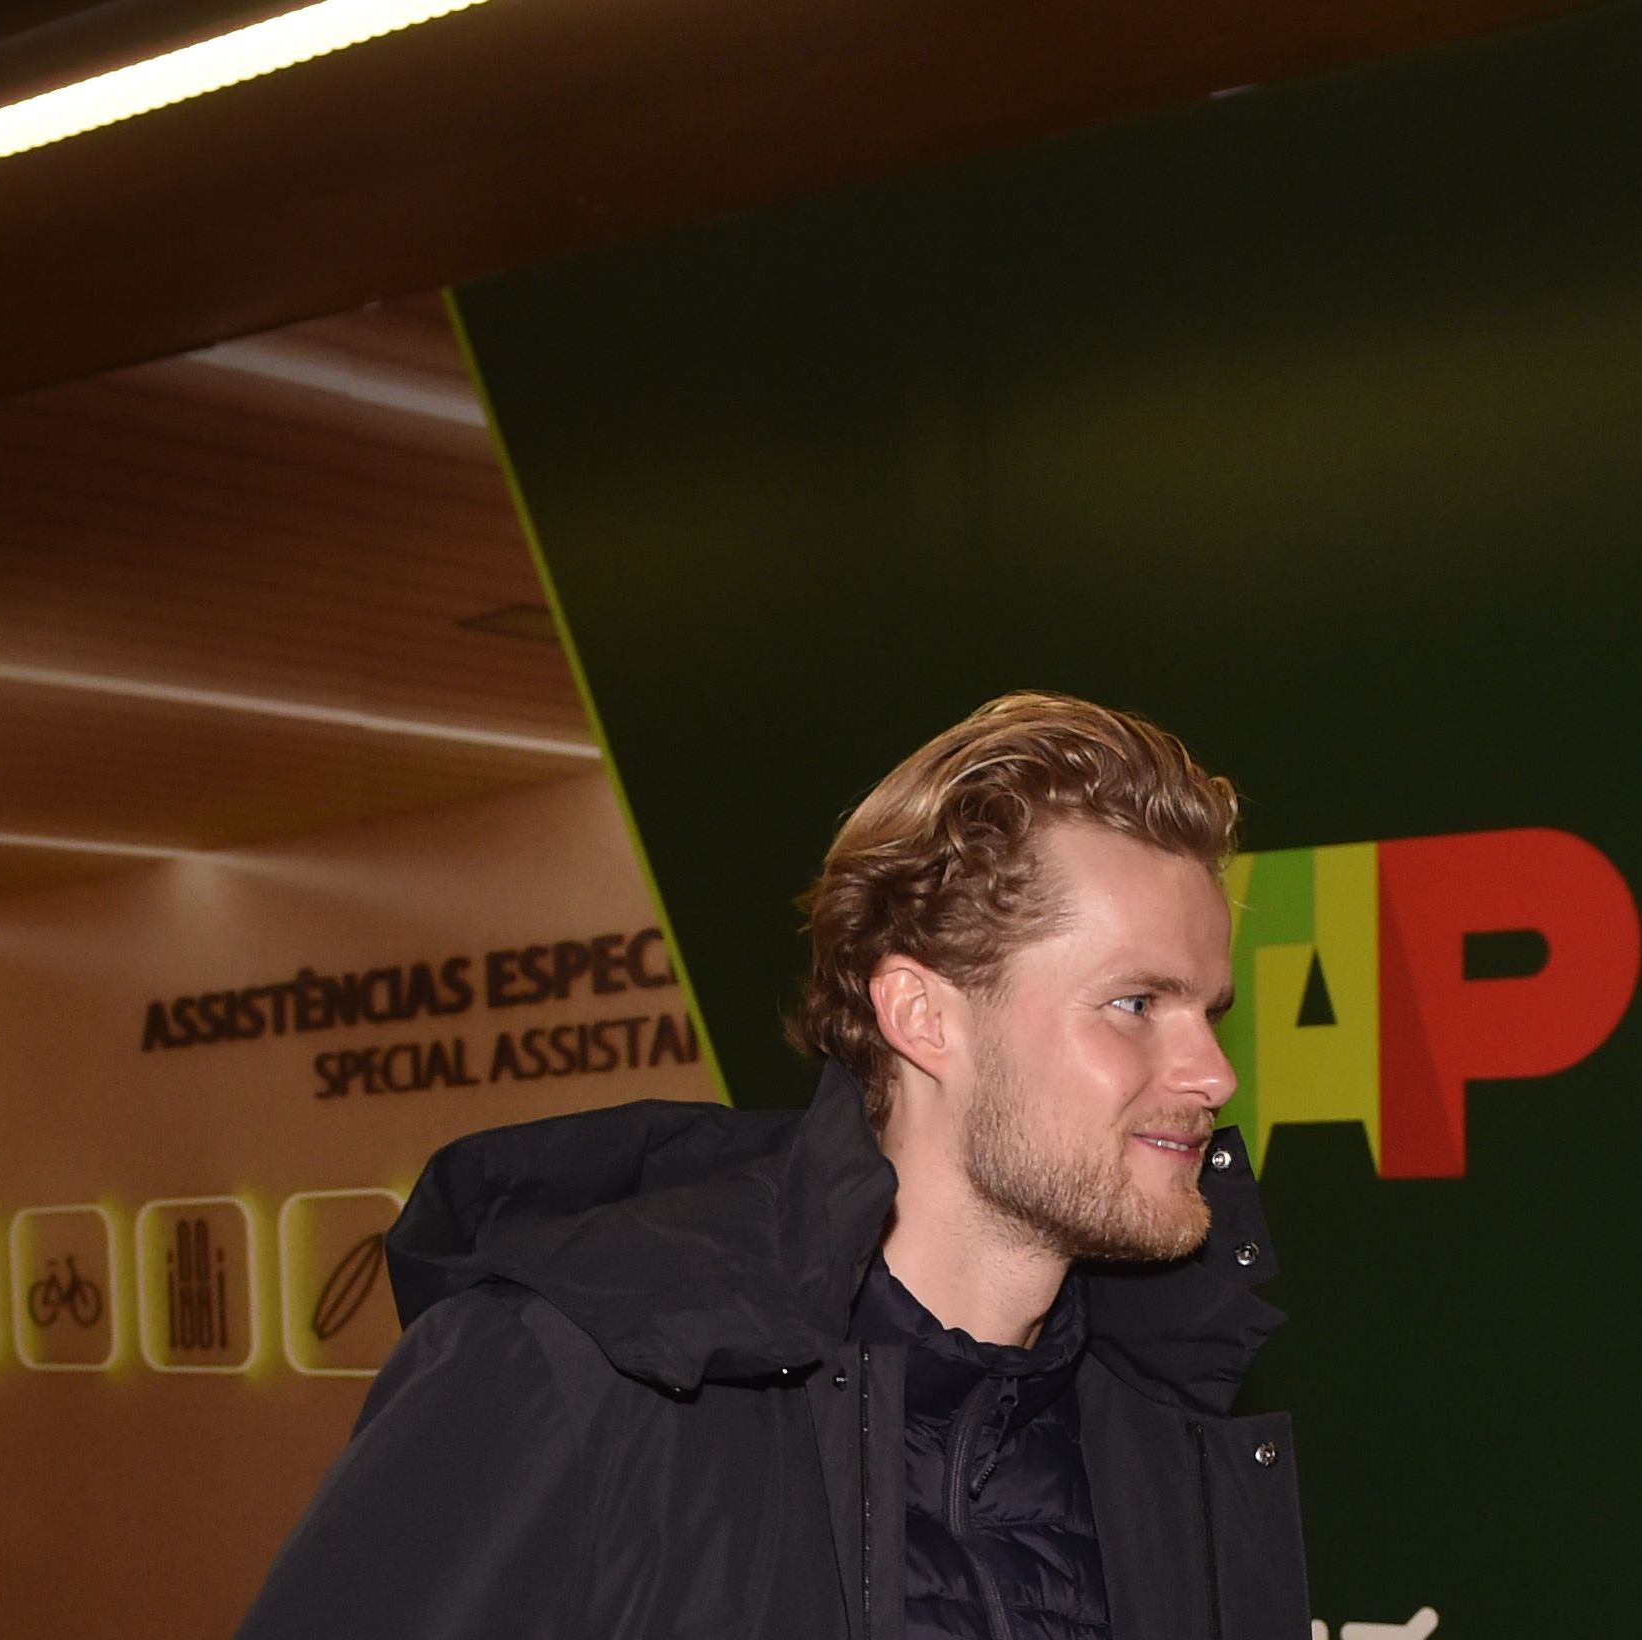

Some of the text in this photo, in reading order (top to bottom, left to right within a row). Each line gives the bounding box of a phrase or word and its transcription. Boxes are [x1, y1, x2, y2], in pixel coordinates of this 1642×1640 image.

[141, 927, 679, 1052] ASSISTÊNCIAS ESPEC
[313, 1037, 479, 1099] SPECIAL
